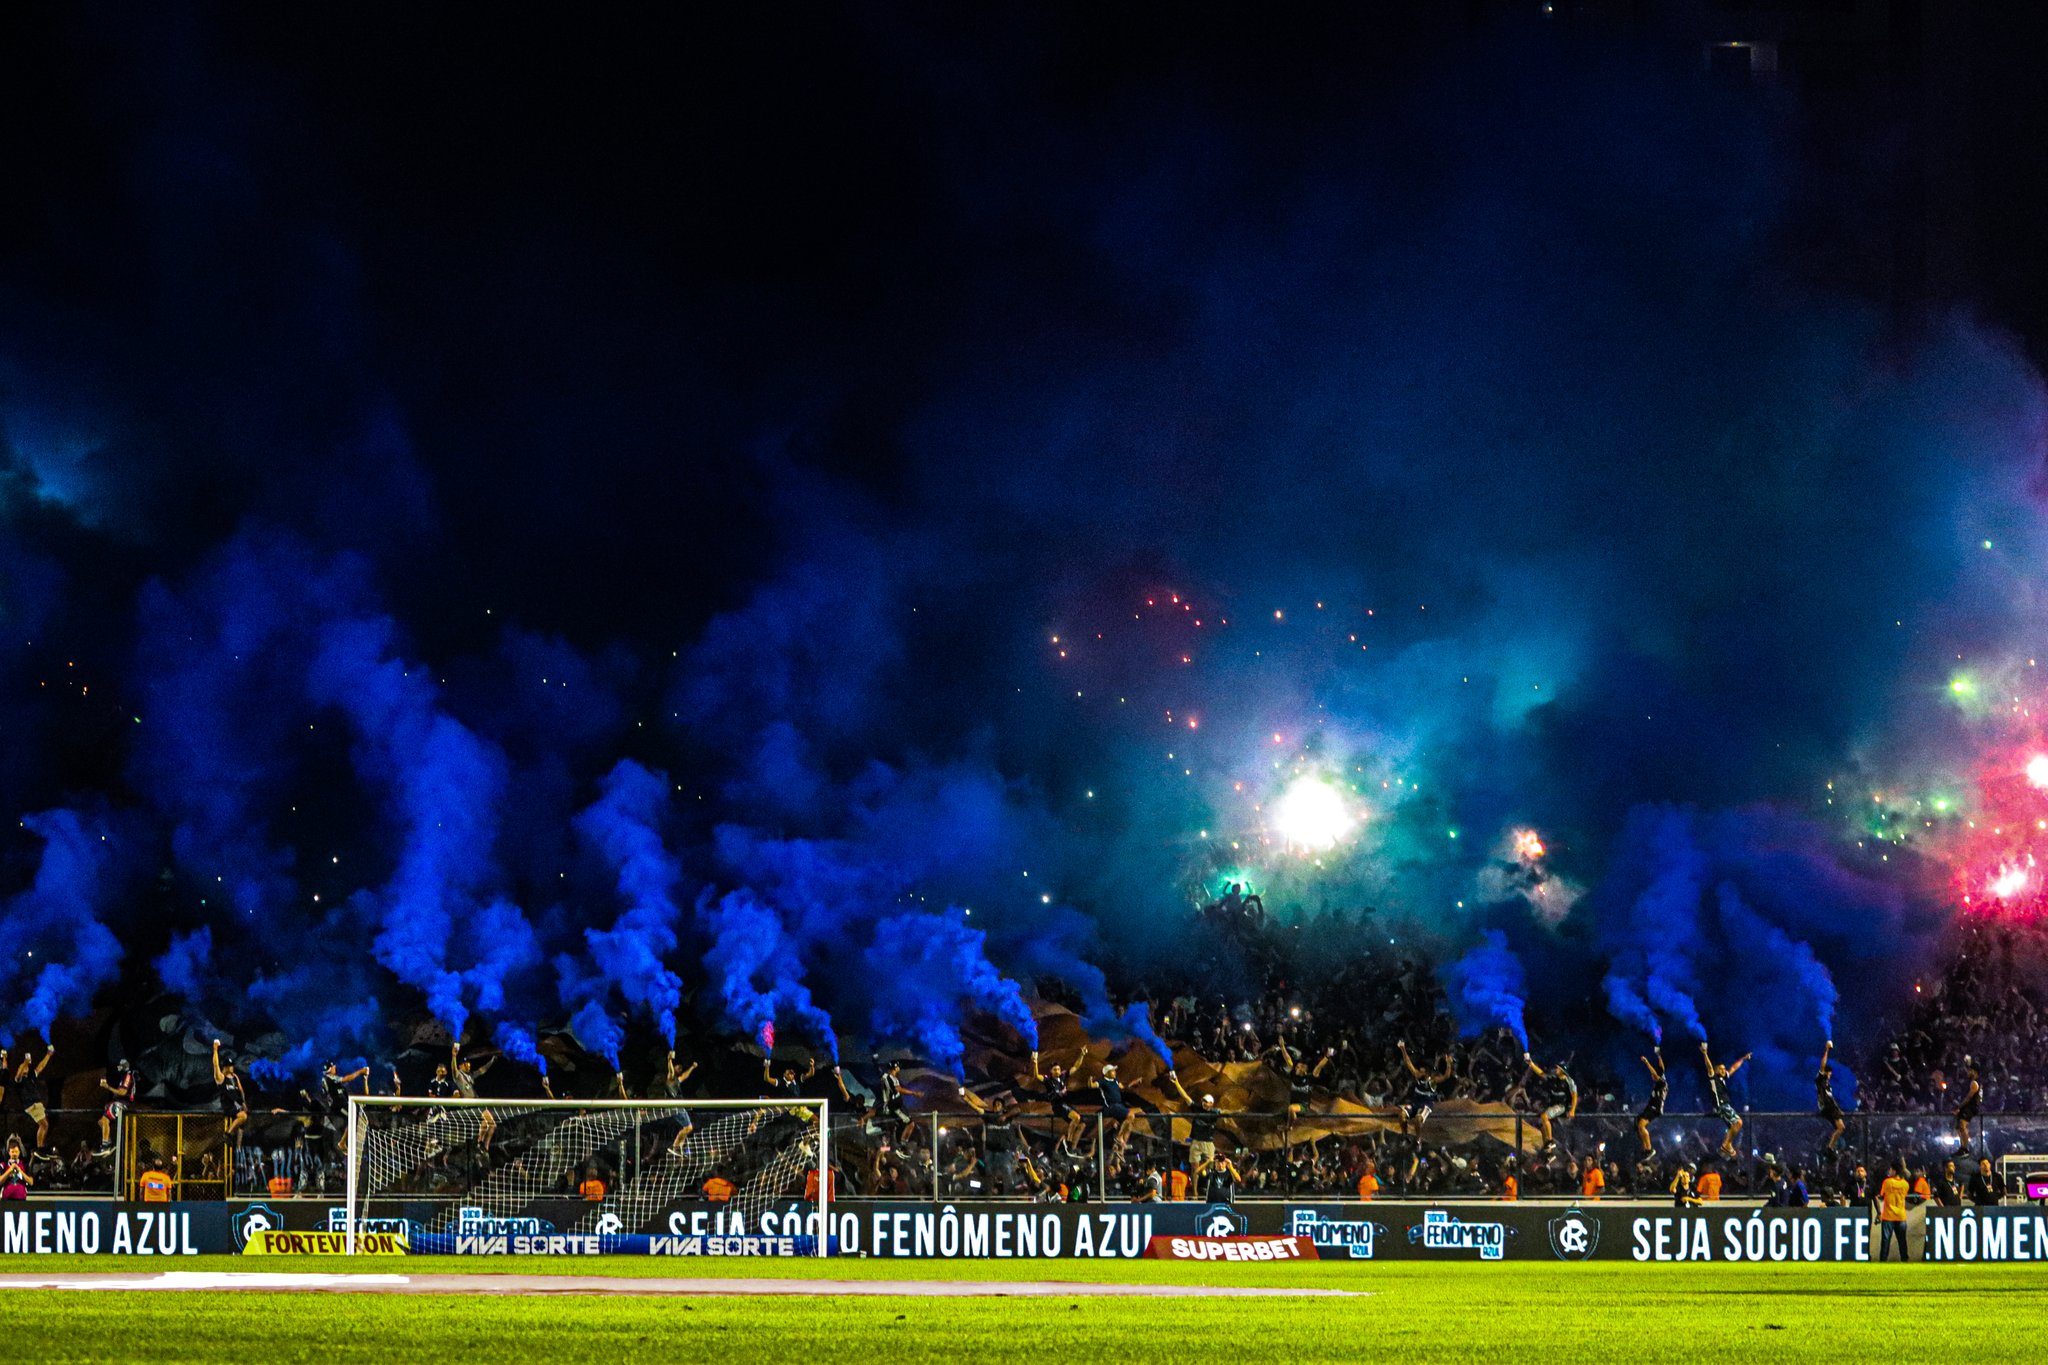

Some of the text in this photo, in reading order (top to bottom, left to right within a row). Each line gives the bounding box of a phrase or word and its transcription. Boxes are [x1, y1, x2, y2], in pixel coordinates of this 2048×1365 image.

[4, 1211, 198, 1255] MENO AZUL
[456, 1236, 600, 1254] VIVA SORTE
[650, 1237, 794, 1256] VIVA SORTE
[873, 1205, 1061, 1257] FENÔMENO
[1632, 1217, 1711, 1261] SEJA
[1723, 1209, 1821, 1261] SÓCIO
[1171, 1237, 1300, 1260] SUPERBET
